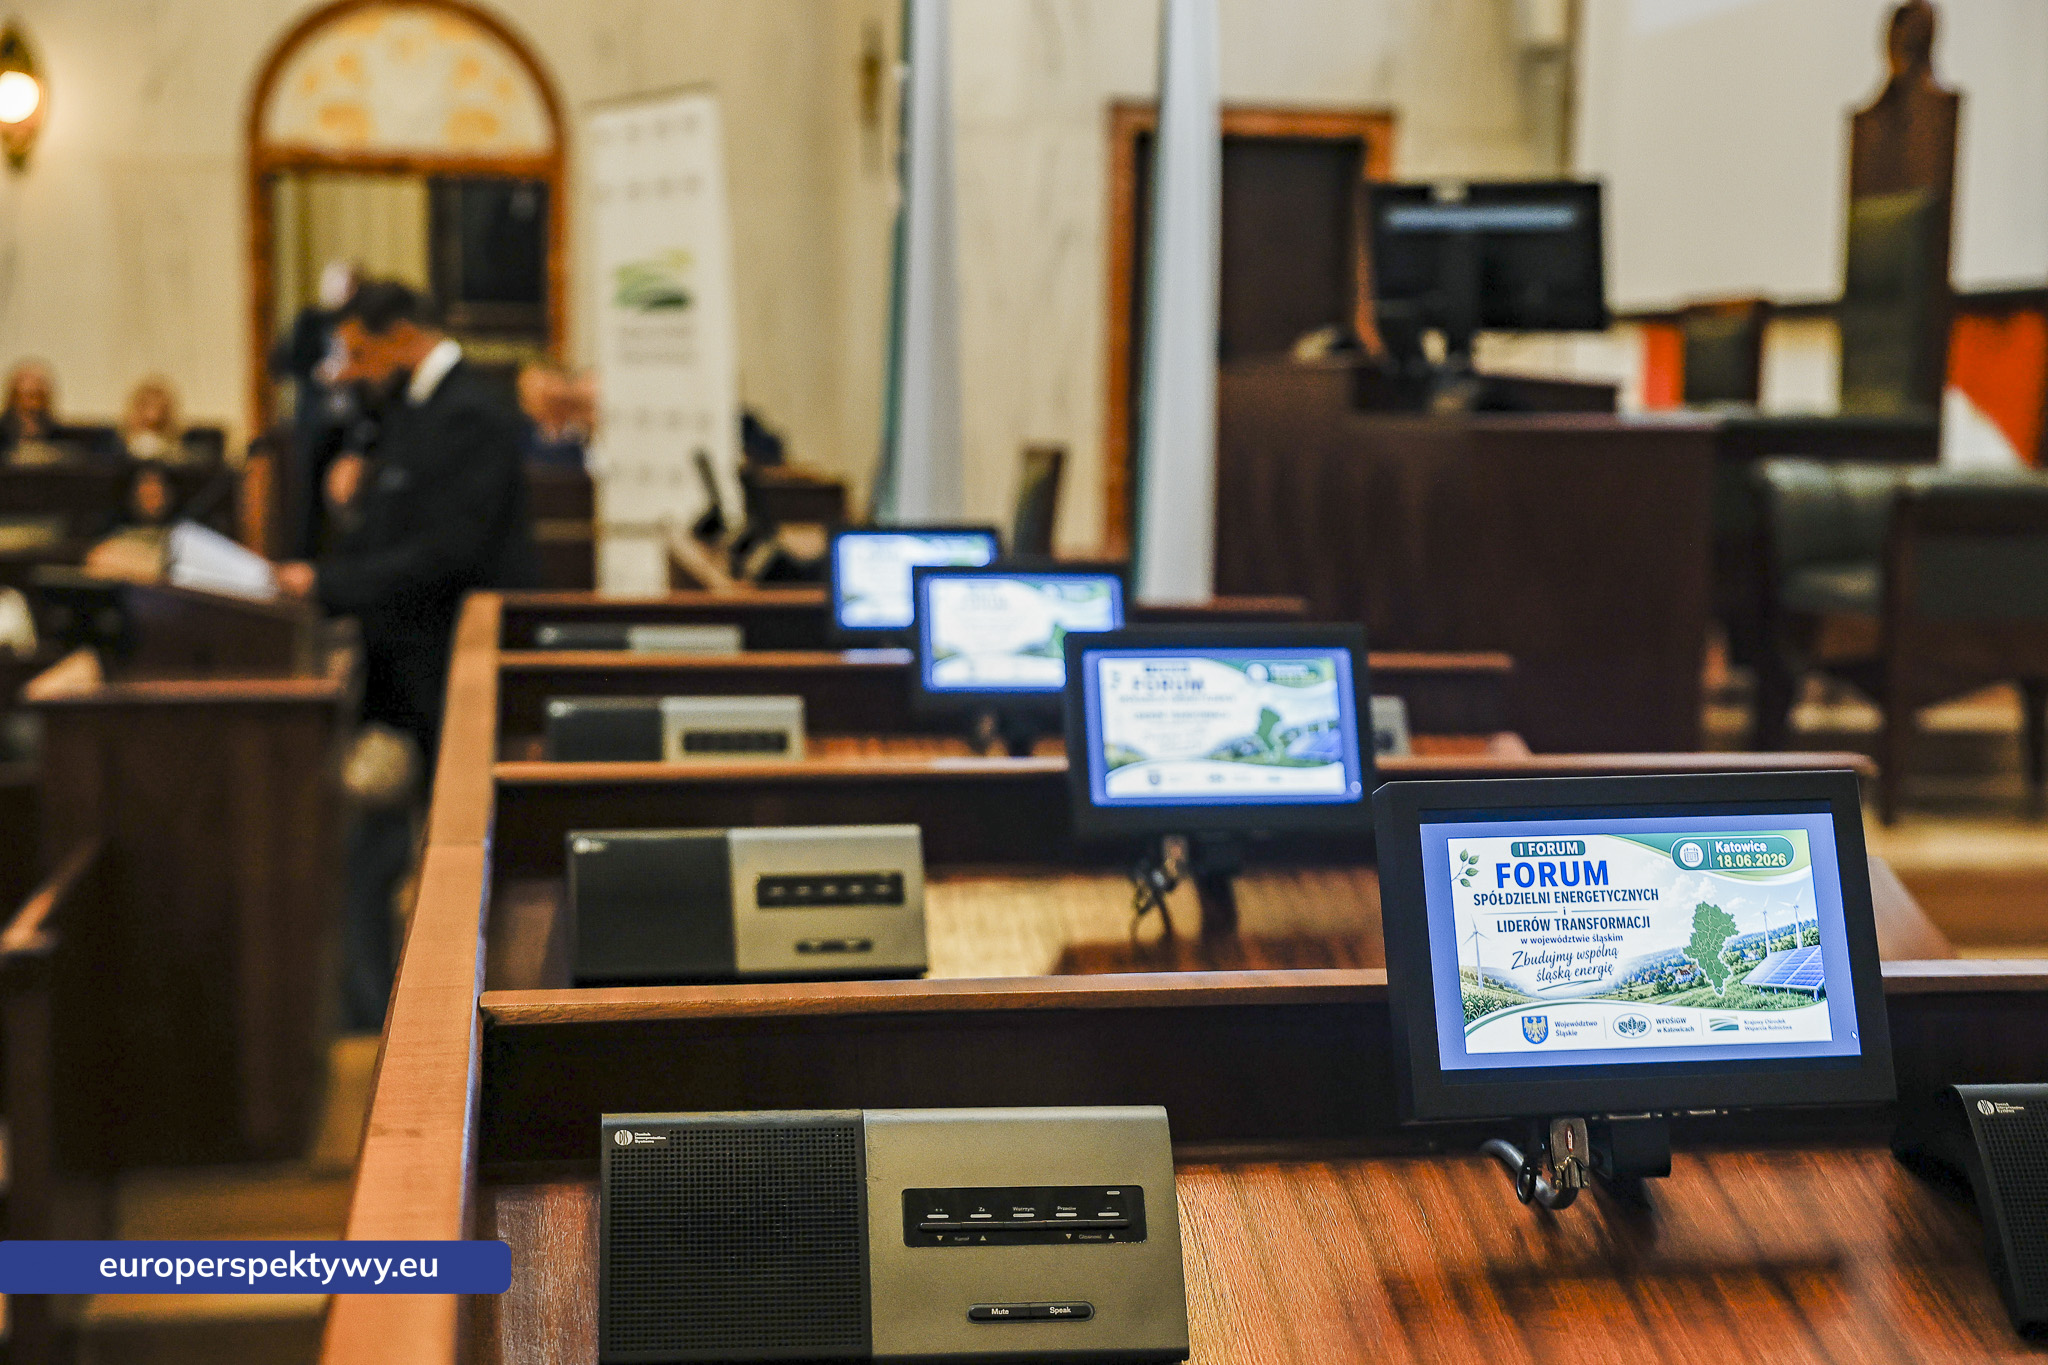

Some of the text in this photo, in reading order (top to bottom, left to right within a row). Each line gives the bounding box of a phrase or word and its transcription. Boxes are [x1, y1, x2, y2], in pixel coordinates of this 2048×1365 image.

[1518, 842, 1579, 856] I FORUM
[1715, 840, 1768, 853] Katowice
[1717, 853, 1787, 868] 18.06.2026
[1495, 860, 1609, 888] FORUM
[1473, 888, 1659, 906] SPÓŁDZIELNI ENERGETYCZNYCH
[1497, 915, 1651, 933] LIDERÓW TRANSFORMACJI
[1530, 935, 1590, 946] województwie
[1592, 933, 1624, 945] śląskim
[1511, 944, 1619, 970] Zbudujmy wspólną
[1574, 962, 1615, 981] energię
[1555, 1029, 1578, 1038] Śląskie
[1049, 1306, 1072, 1315] Speak
